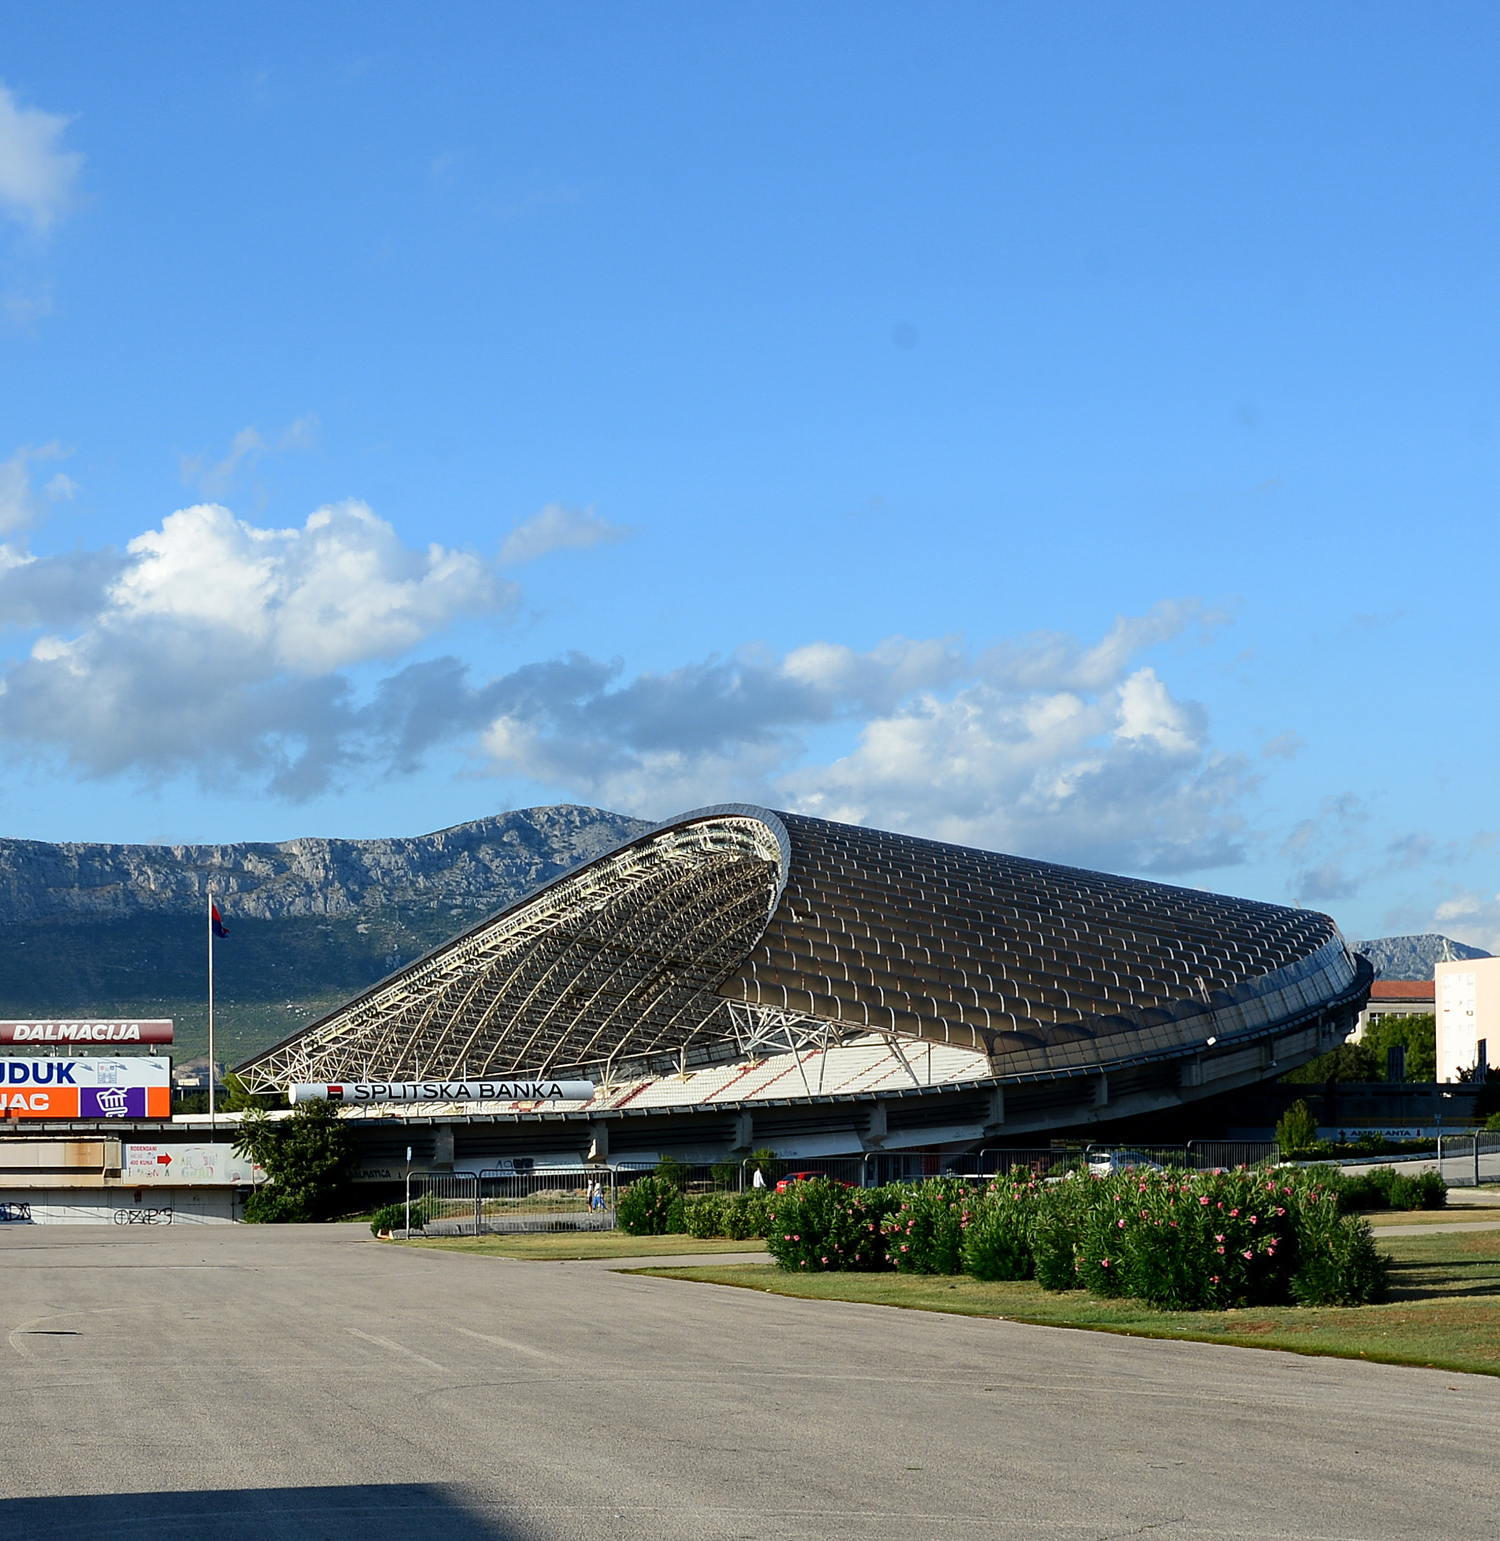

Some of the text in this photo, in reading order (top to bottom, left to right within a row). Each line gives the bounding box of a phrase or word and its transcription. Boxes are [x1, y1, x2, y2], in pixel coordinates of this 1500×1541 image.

[12, 1024, 141, 1041] DALMACIJA
[354, 1083, 564, 1099] SPLITSKA BANKA
